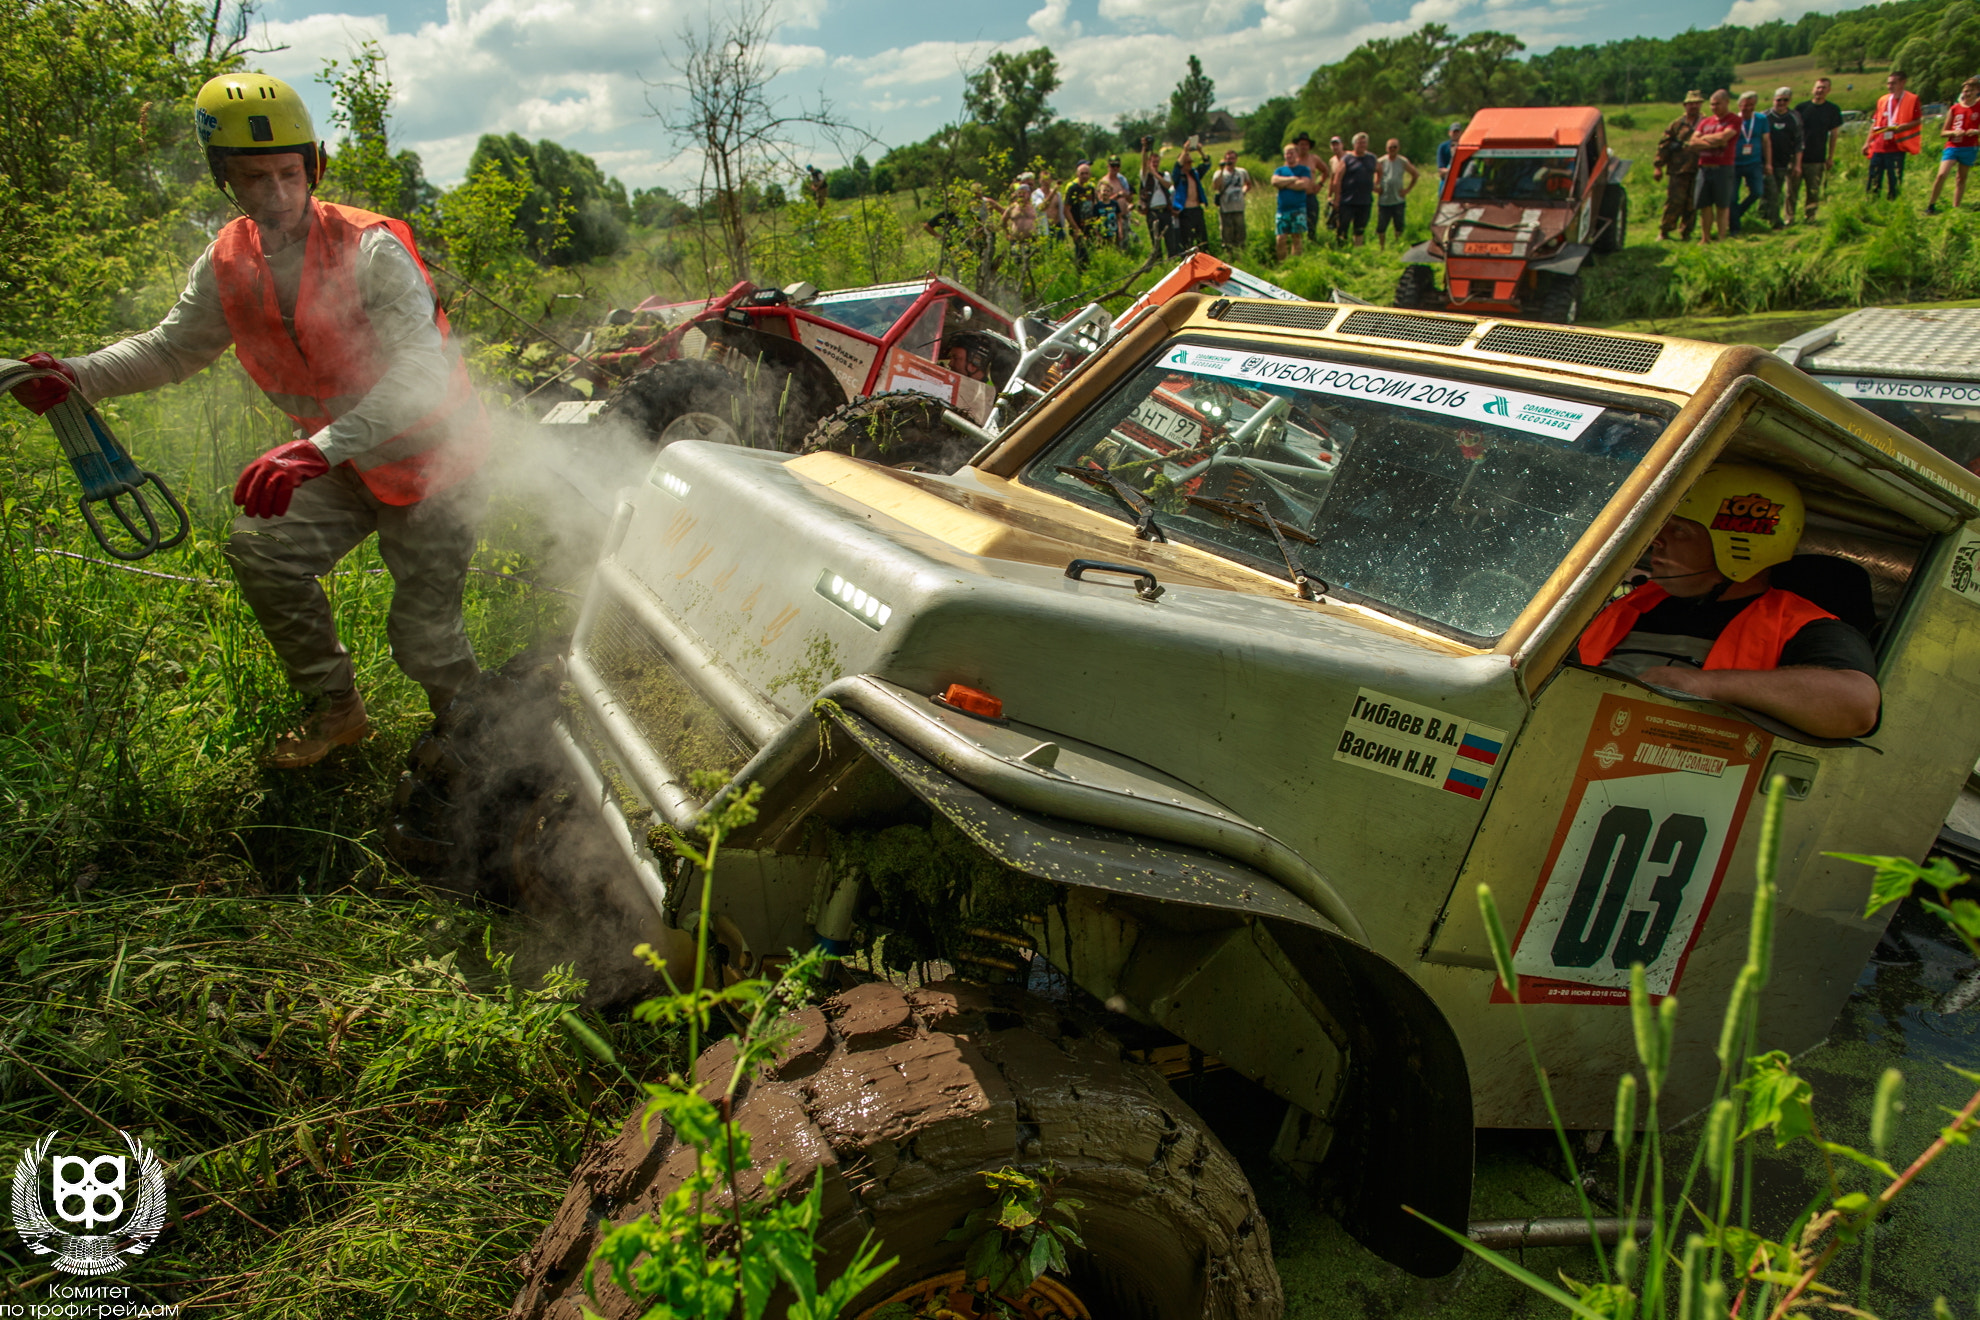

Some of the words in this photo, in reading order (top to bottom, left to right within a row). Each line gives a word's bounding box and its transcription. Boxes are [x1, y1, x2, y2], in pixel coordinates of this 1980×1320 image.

[1256, 361, 1324, 384] КУБОК
[1319, 370, 1416, 399] РОССИИ
[1410, 384, 1470, 408] 2016
[1875, 382, 1938, 399] КУБОК
[1515, 413, 1571, 431] ЛЕСОЗАВОД
[1523, 403, 1584, 421] СОЛОМЕНСКИЙ
[1169, 432, 1183, 443] RUS
[1175, 418, 1196, 438] 97
[1717, 498, 1785, 520] LOCK
[1710, 514, 1779, 535] RIGHT
[1351, 695, 1424, 735] Гибаев
[1424, 717, 1459, 747] В.А.
[1645, 715, 1664, 725] КУБОК
[1664, 719, 1688, 730] РОССИИ
[1337, 730, 1403, 768] Васин
[1402, 750, 1438, 779] Н.Н.
[1550, 805, 1707, 970] 03
